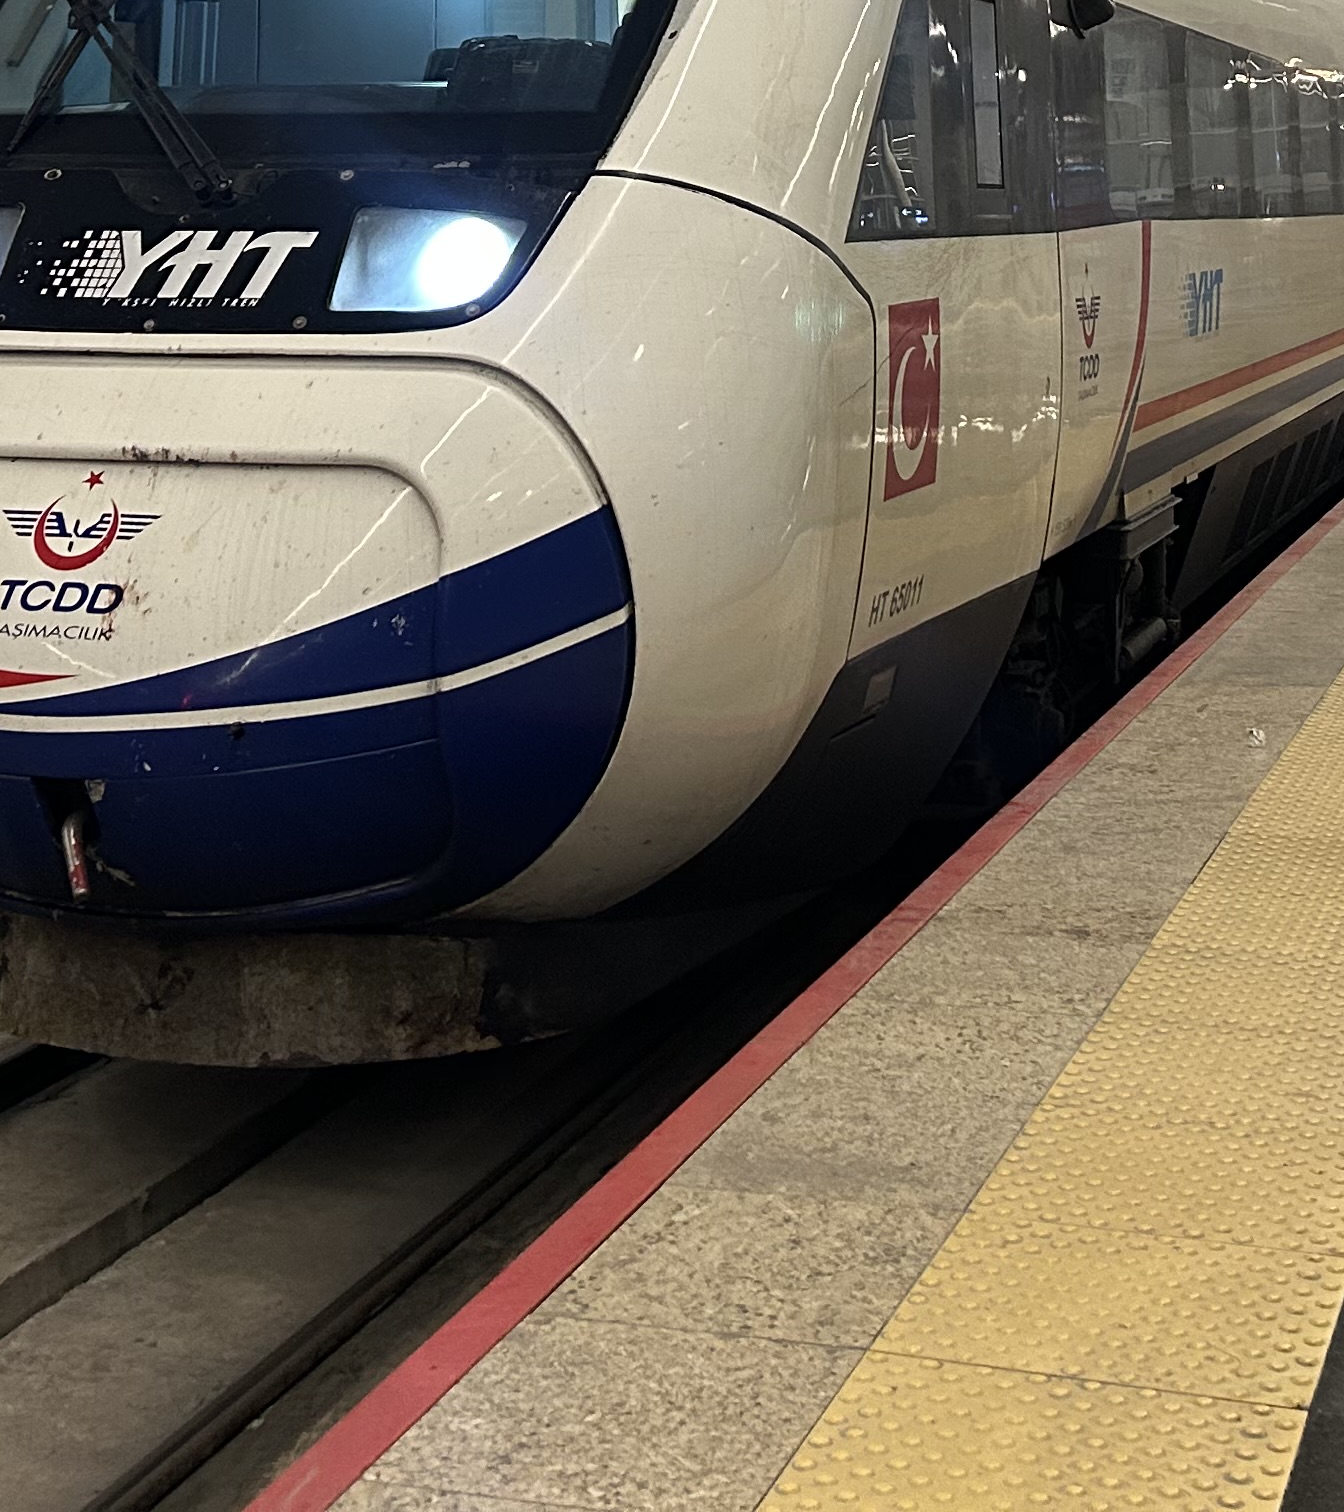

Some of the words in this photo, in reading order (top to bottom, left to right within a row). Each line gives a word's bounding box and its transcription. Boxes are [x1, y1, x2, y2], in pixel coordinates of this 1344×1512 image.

[107, 230, 319, 298] YHT
[1189, 268, 1224, 338] YHT
[0, 579, 125, 615] TCDD
[868, 589, 890, 628] HT
[889, 573, 925, 618] 65011
